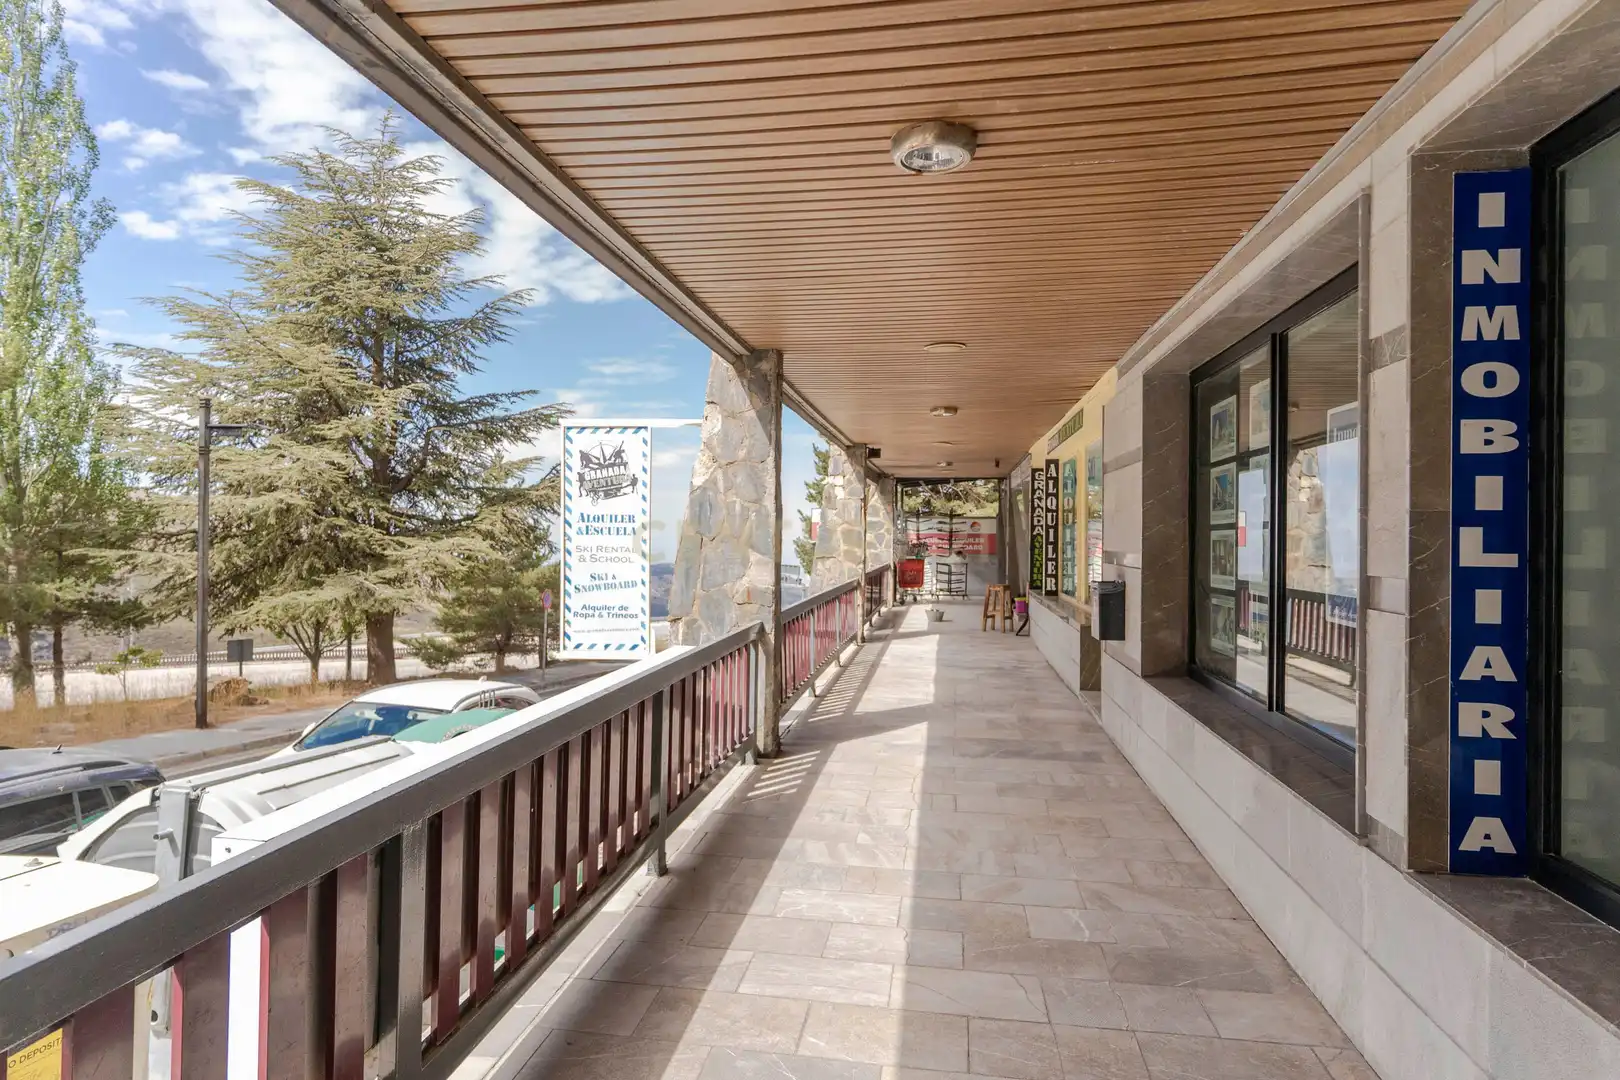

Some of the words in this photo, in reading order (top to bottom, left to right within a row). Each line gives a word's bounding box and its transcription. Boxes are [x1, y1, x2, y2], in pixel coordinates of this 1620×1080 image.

[585, 466, 626, 481] GRANADA
[1034, 471, 1044, 535] GRANADA
[577, 512, 636, 524] ALQUILER
[1457, 191, 1522, 855] INMOBILIARIA
[1045, 463, 1057, 591] ALQUILER
[575, 545, 593, 553] SKI
[596, 545, 637, 553] RENTAL
[578, 554, 587, 563] &
[589, 553, 634, 563] SCHOOL
[589, 572, 609, 582] SKI
[611, 573, 617, 581] &
[574, 580, 638, 594] SNOWBOARD
[581, 604, 616, 613] Alquiler
[617, 604, 629, 612] de
[573, 611, 595, 620] Ropa
[597, 611, 604, 619] &
[607, 611, 639, 620] Trineos
[19, 1037, 63, 1064] DEPOSIT
